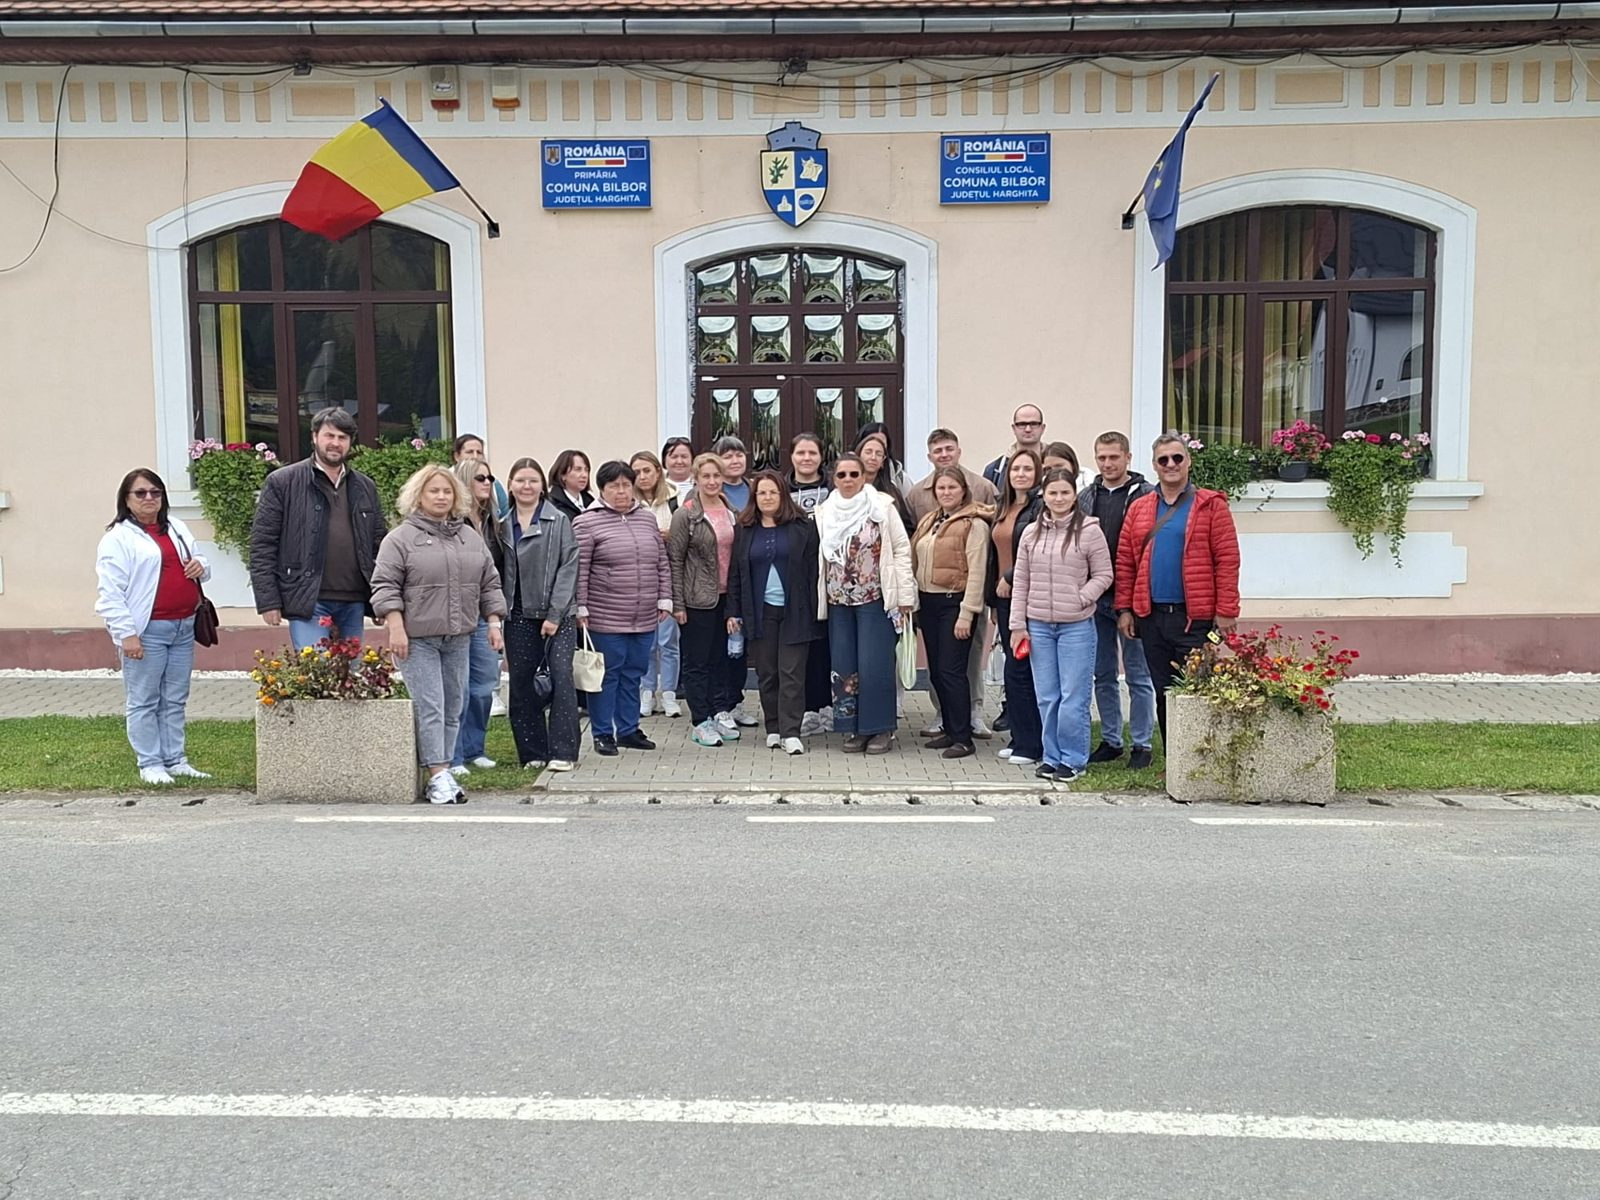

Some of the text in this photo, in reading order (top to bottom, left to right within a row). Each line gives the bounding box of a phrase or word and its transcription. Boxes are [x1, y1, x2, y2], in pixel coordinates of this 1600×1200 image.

[963, 138, 1026, 151] ROMÂNIA
[564, 144, 626, 157] ROMÂNIA
[574, 170, 618, 179] PRIMĂRIA
[955, 165, 1034, 174] CONSILIUL LOCAL
[943, 176, 1046, 188] COMUNA BILBOR
[546, 182, 647, 193] COMUNA BILBOR
[993, 189, 1039, 198] HARGHITA
[595, 195, 640, 203] HARGHITA
